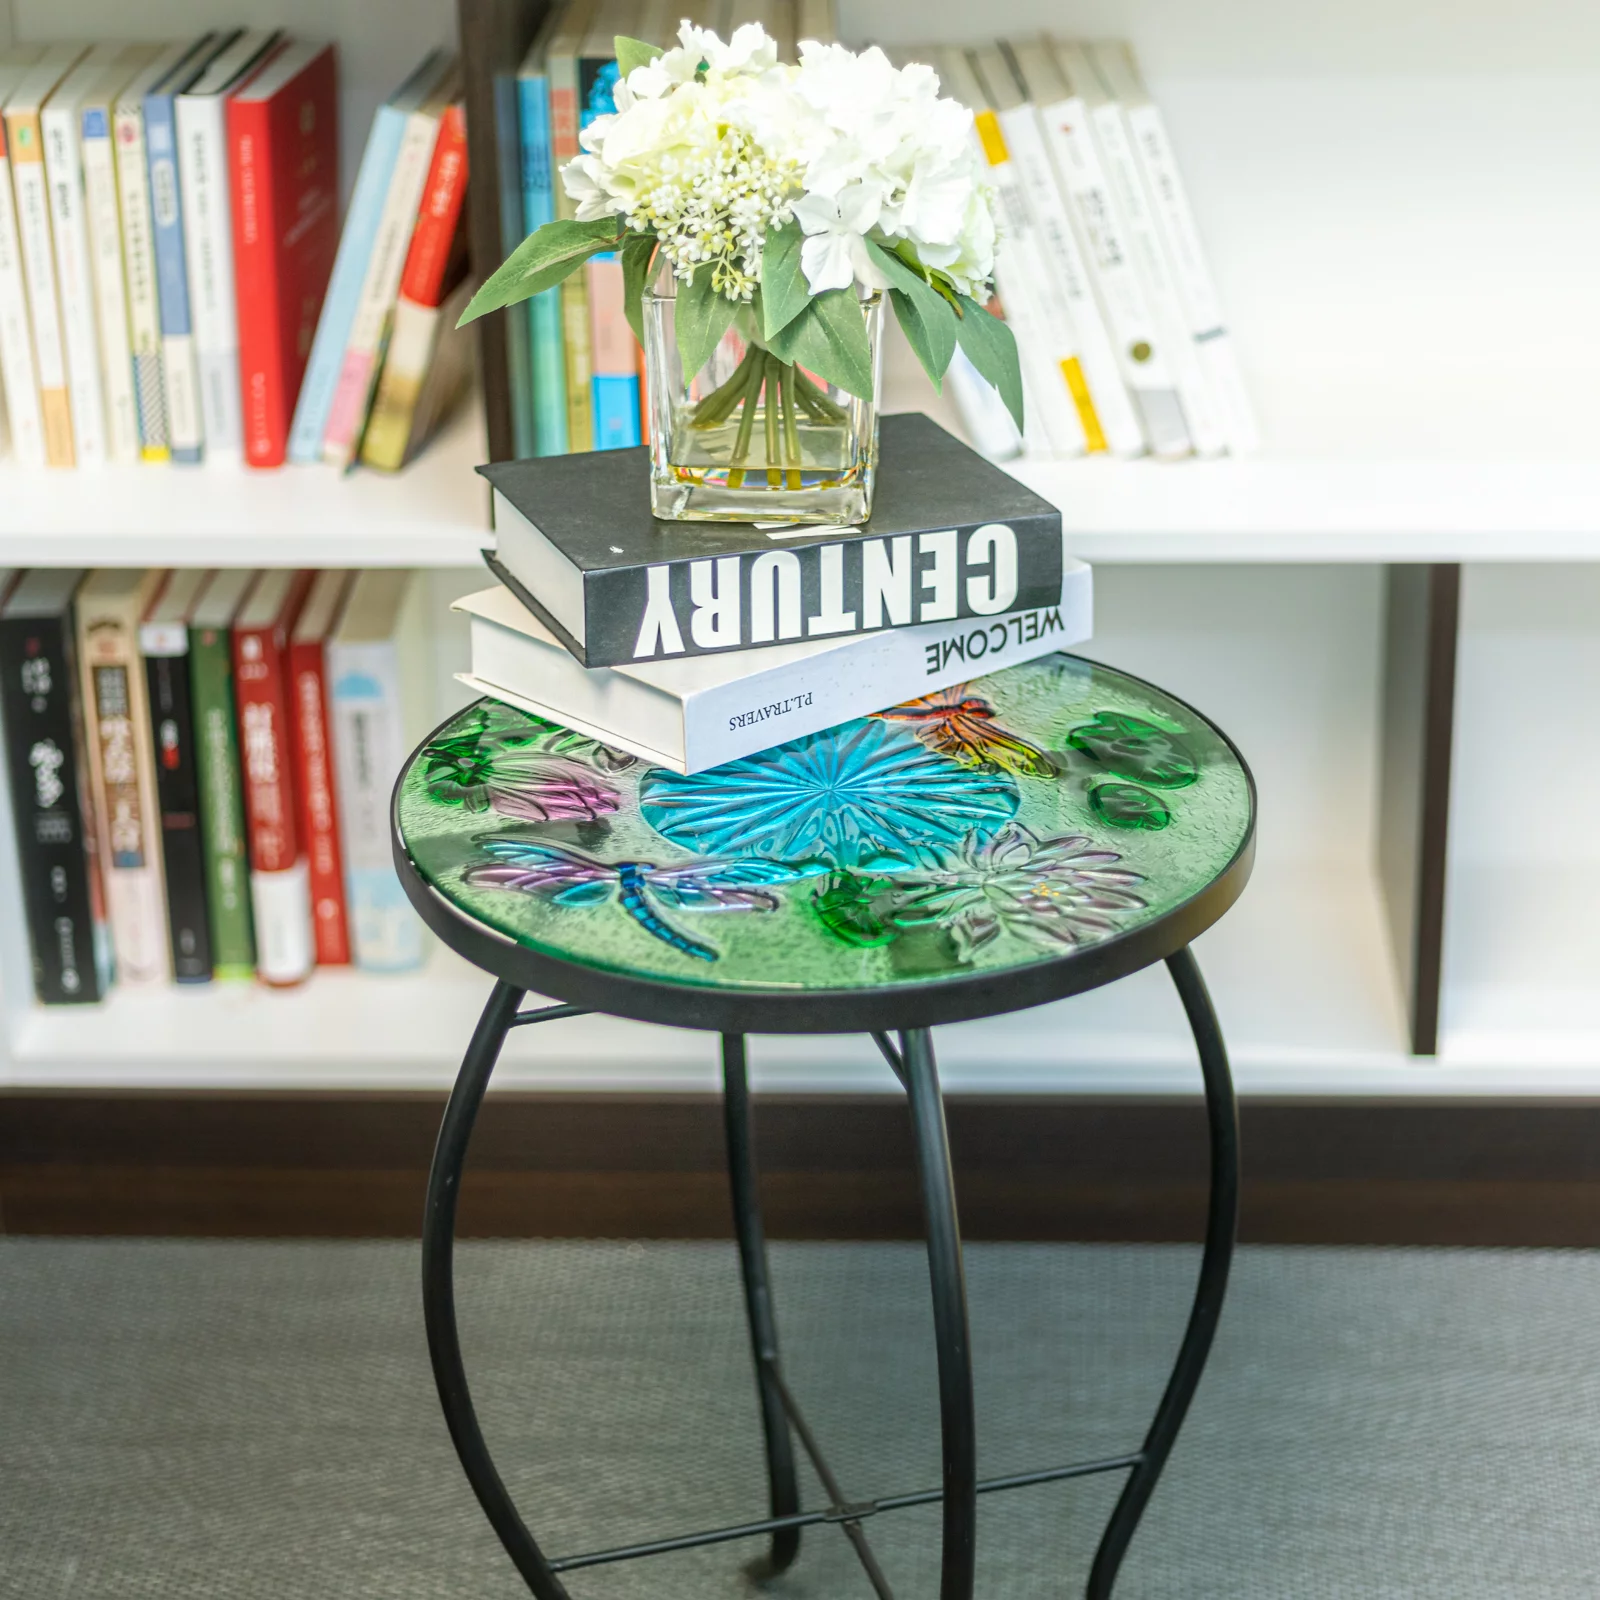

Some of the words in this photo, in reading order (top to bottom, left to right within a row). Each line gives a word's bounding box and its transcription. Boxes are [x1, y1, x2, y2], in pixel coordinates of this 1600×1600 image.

[634, 523, 1019, 658] CENTURY
[925, 607, 1064, 675] WELCOME
[728, 691, 814, 732] P.L.TRAVERS
